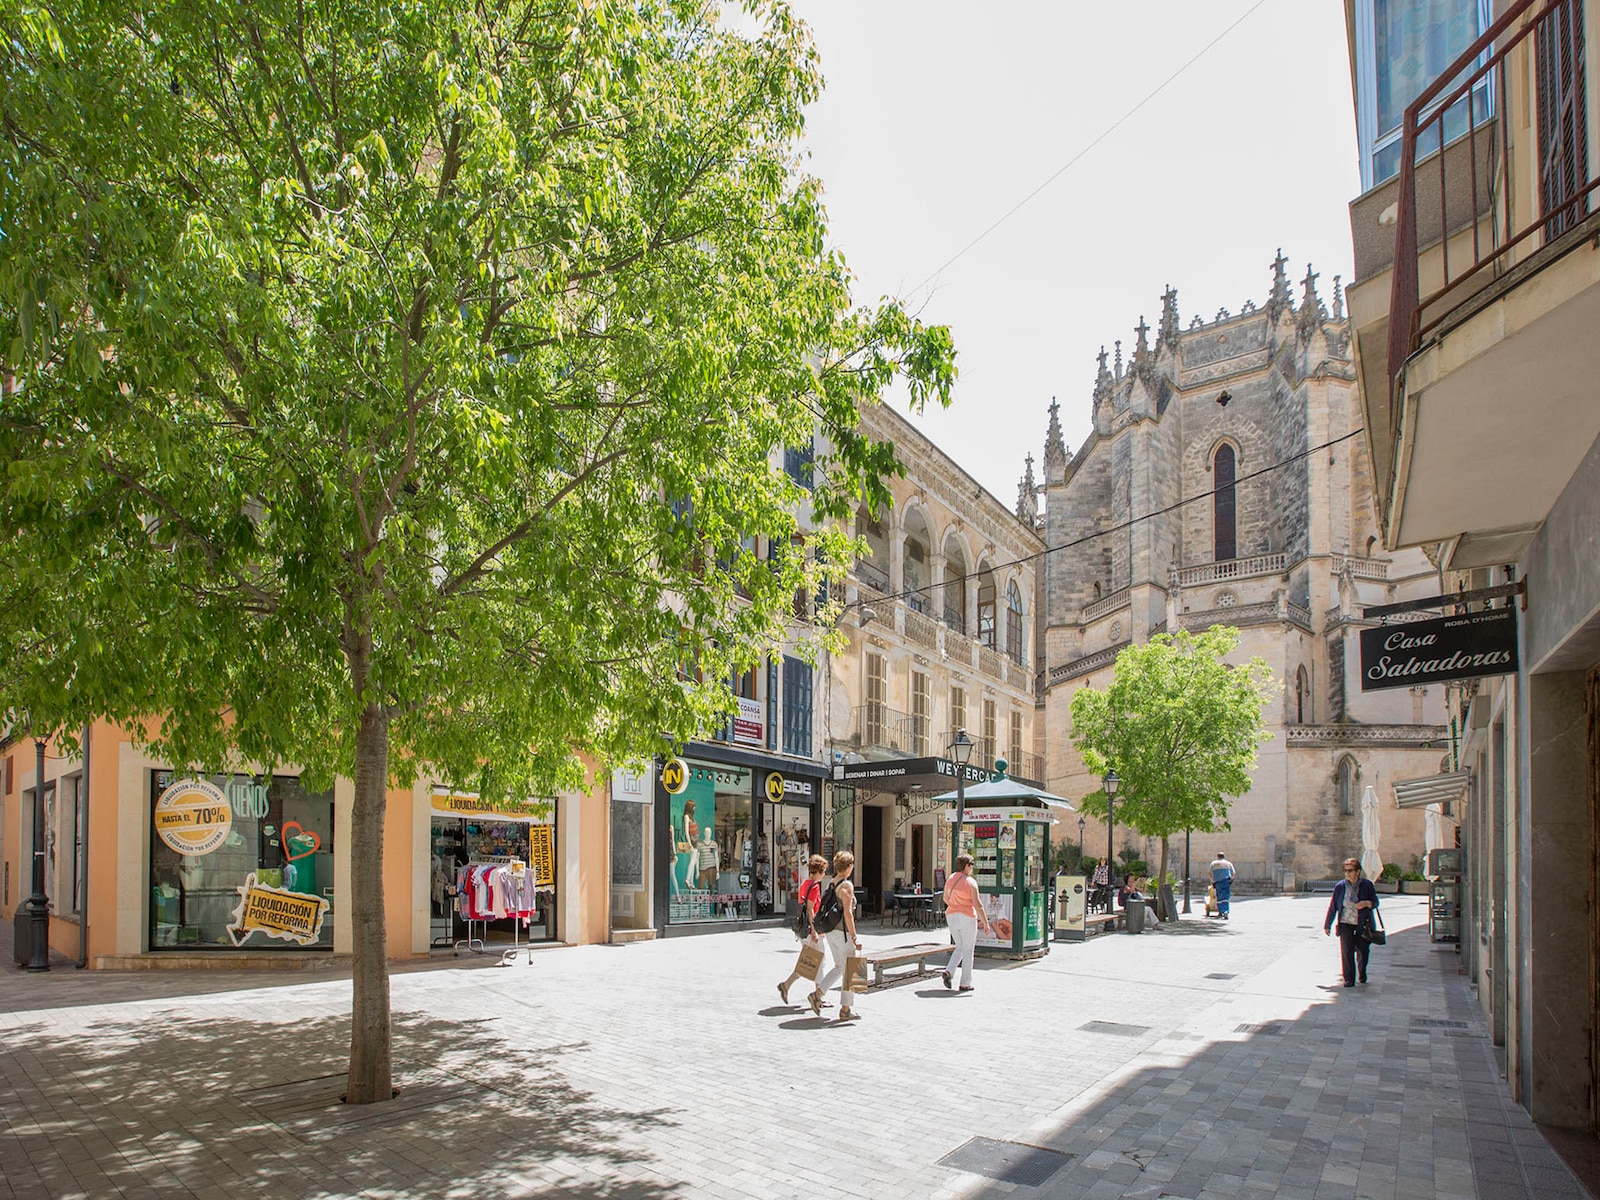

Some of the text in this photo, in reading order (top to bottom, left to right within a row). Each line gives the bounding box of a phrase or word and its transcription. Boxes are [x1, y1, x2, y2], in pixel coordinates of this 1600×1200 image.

[1445, 613, 1509, 628] ROBA D'HOME
[1384, 631, 1438, 651] Casa
[1368, 650, 1511, 680] Salvadoras
[741, 704, 760, 714] COANSA
[665, 769, 681, 784] IN
[845, 771, 867, 779] BERENAR
[161, 814, 183, 823] HASTA
[193, 806, 225, 825] 70%
[252, 896, 312, 918] LIQUIDACIÓN
[249, 908, 308, 929] POR REFORMA
